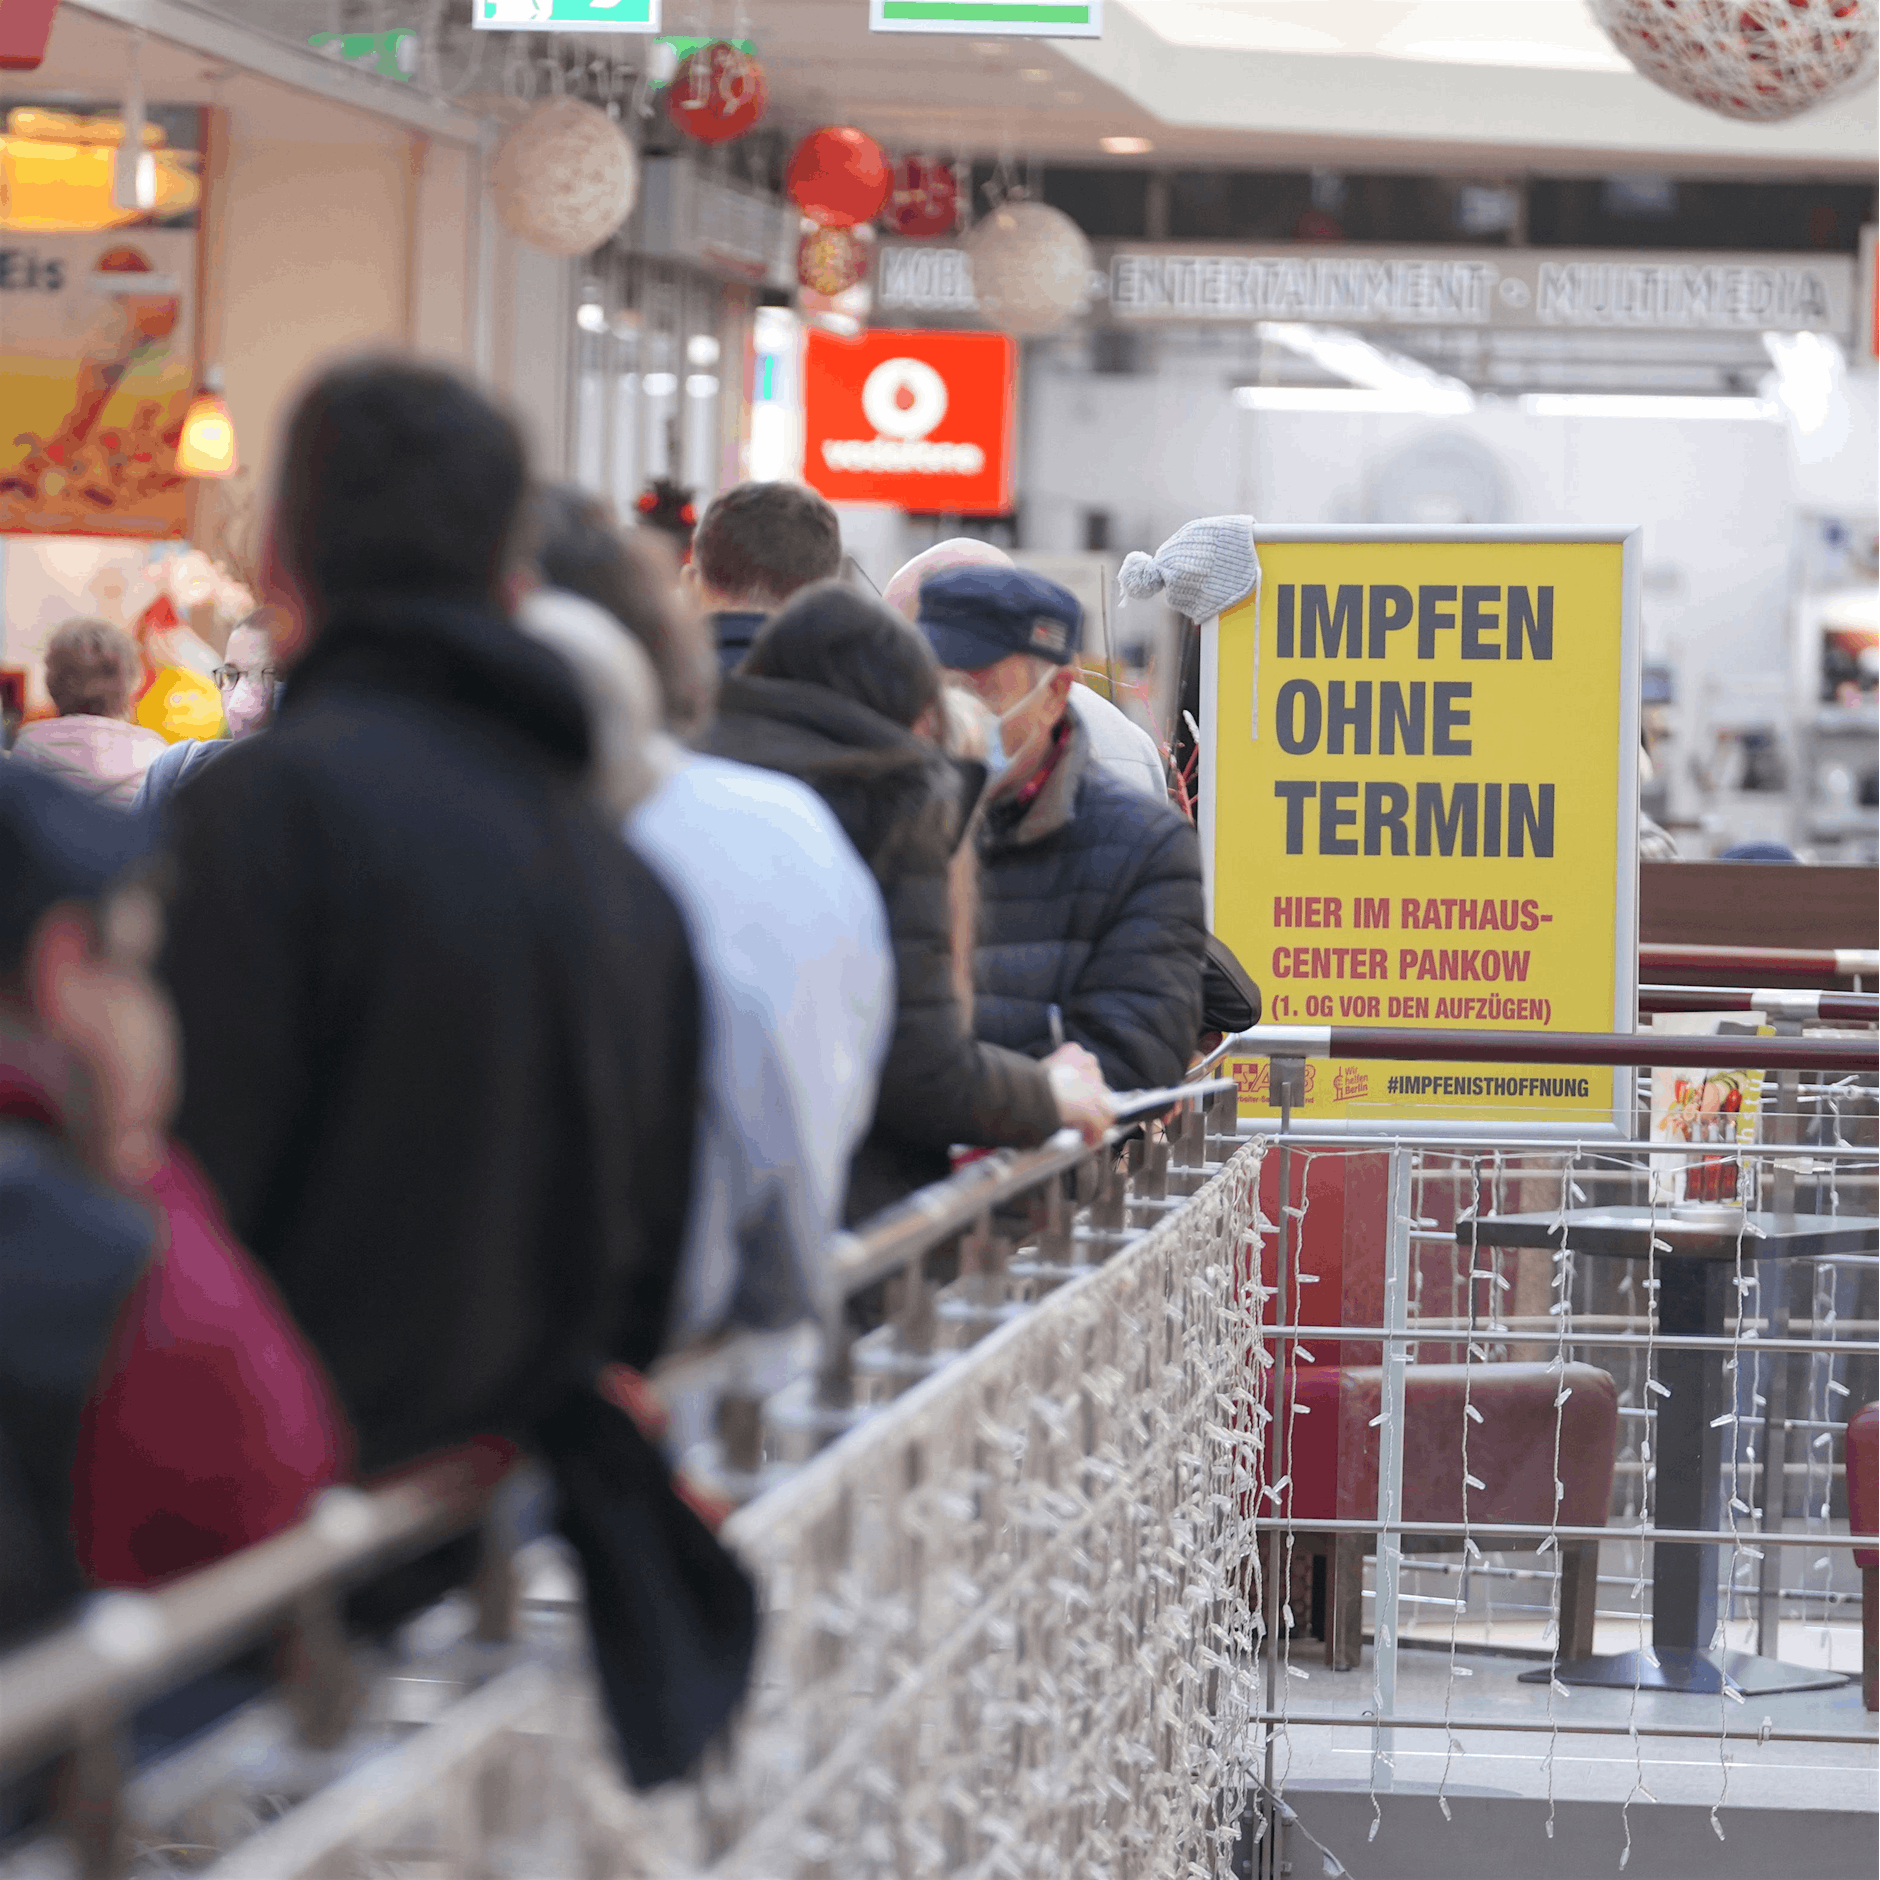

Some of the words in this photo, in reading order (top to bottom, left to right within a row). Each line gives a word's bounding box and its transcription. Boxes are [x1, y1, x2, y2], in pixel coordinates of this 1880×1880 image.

[1109, 254, 1495, 319] ENTERTAINMENT
[1536, 261, 1828, 325] MULTIMEDIA
[1276, 584, 1555, 660] IMPFEN
[1275, 678, 1472, 756] OHNE
[1274, 780, 1555, 858] TERMIN
[1273, 896, 1342, 928] HIER
[1353, 897, 1390, 929] IM
[1401, 898, 1554, 931] RATHAUS-
[1272, 946, 1388, 980] CENTER
[1399, 948, 1531, 982] PANKOW
[1271, 994, 1299, 1021] (1.
[1305, 995, 1334, 1018] OG
[1339, 996, 1381, 1018] VOR
[1387, 996, 1430, 1019] DEN
[1434, 992, 1552, 1026] AUFZÜGEN)
[1345, 1066, 1359, 1076] Wir
[1387, 1075, 1589, 1098] #IMPFENISTHOFFNUNG
[1345, 1083, 1369, 1095] Berlin
